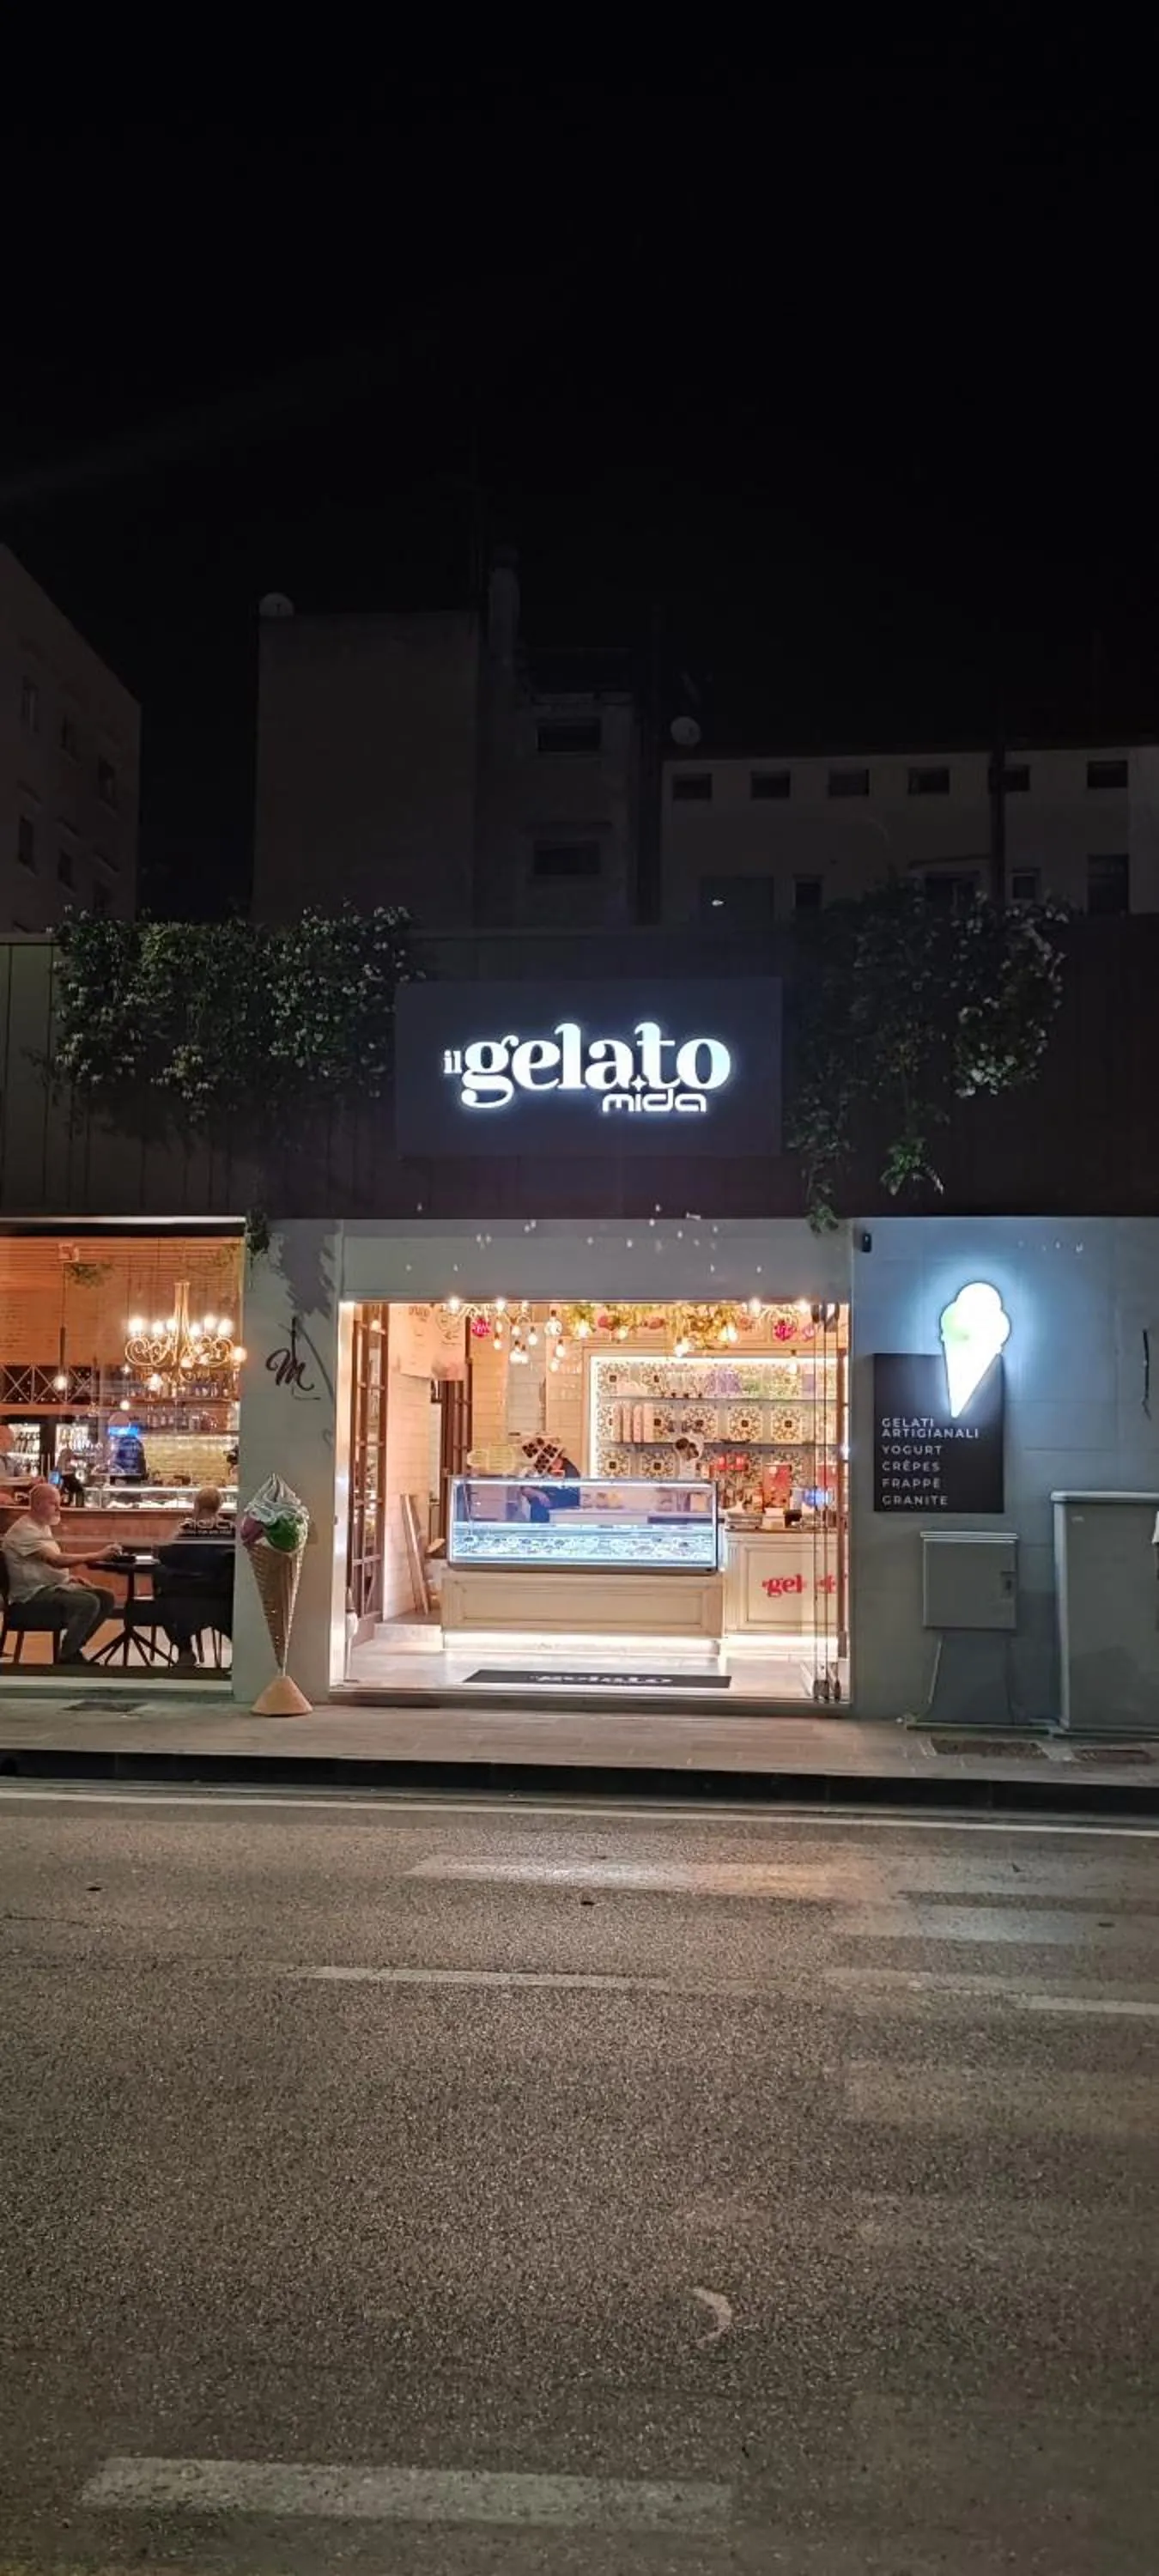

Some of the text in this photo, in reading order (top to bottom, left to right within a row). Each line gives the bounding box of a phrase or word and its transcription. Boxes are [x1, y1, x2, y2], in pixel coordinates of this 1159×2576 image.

[442, 1021, 731, 1109] il gelato
[602, 1088, 707, 1113] mida
[881, 1418, 935, 1428] GELATI
[881, 1428, 980, 1439] ARTIGIANALI
[881, 1445, 943, 1455] YOGURT
[881, 1495, 949, 1505] GRANITE
